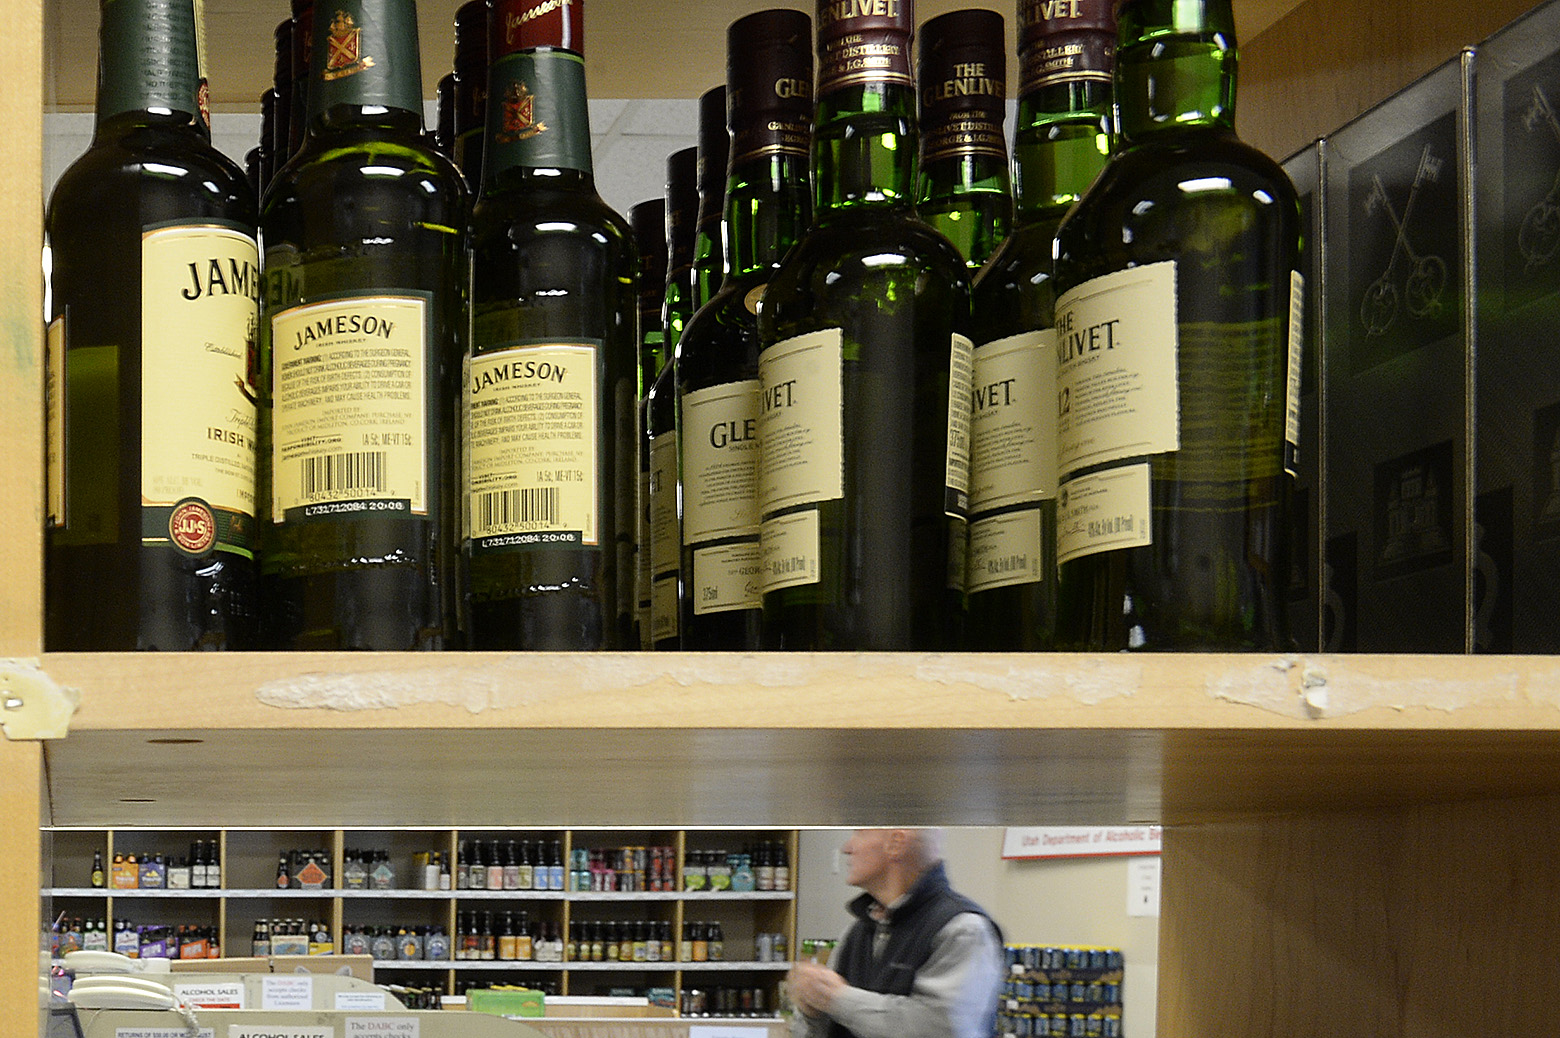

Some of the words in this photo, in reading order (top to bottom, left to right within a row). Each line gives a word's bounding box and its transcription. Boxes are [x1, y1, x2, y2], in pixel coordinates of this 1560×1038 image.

[953, 63, 986, 77] THE
[294, 315, 393, 350] JAMESON
[472, 361, 566, 394] JAMESON
[207, 427, 244, 447] IRISH
[351, 1023, 366, 1031] The
[367, 1022, 393, 1030] DABC
[397, 1023, 414, 1032] only
